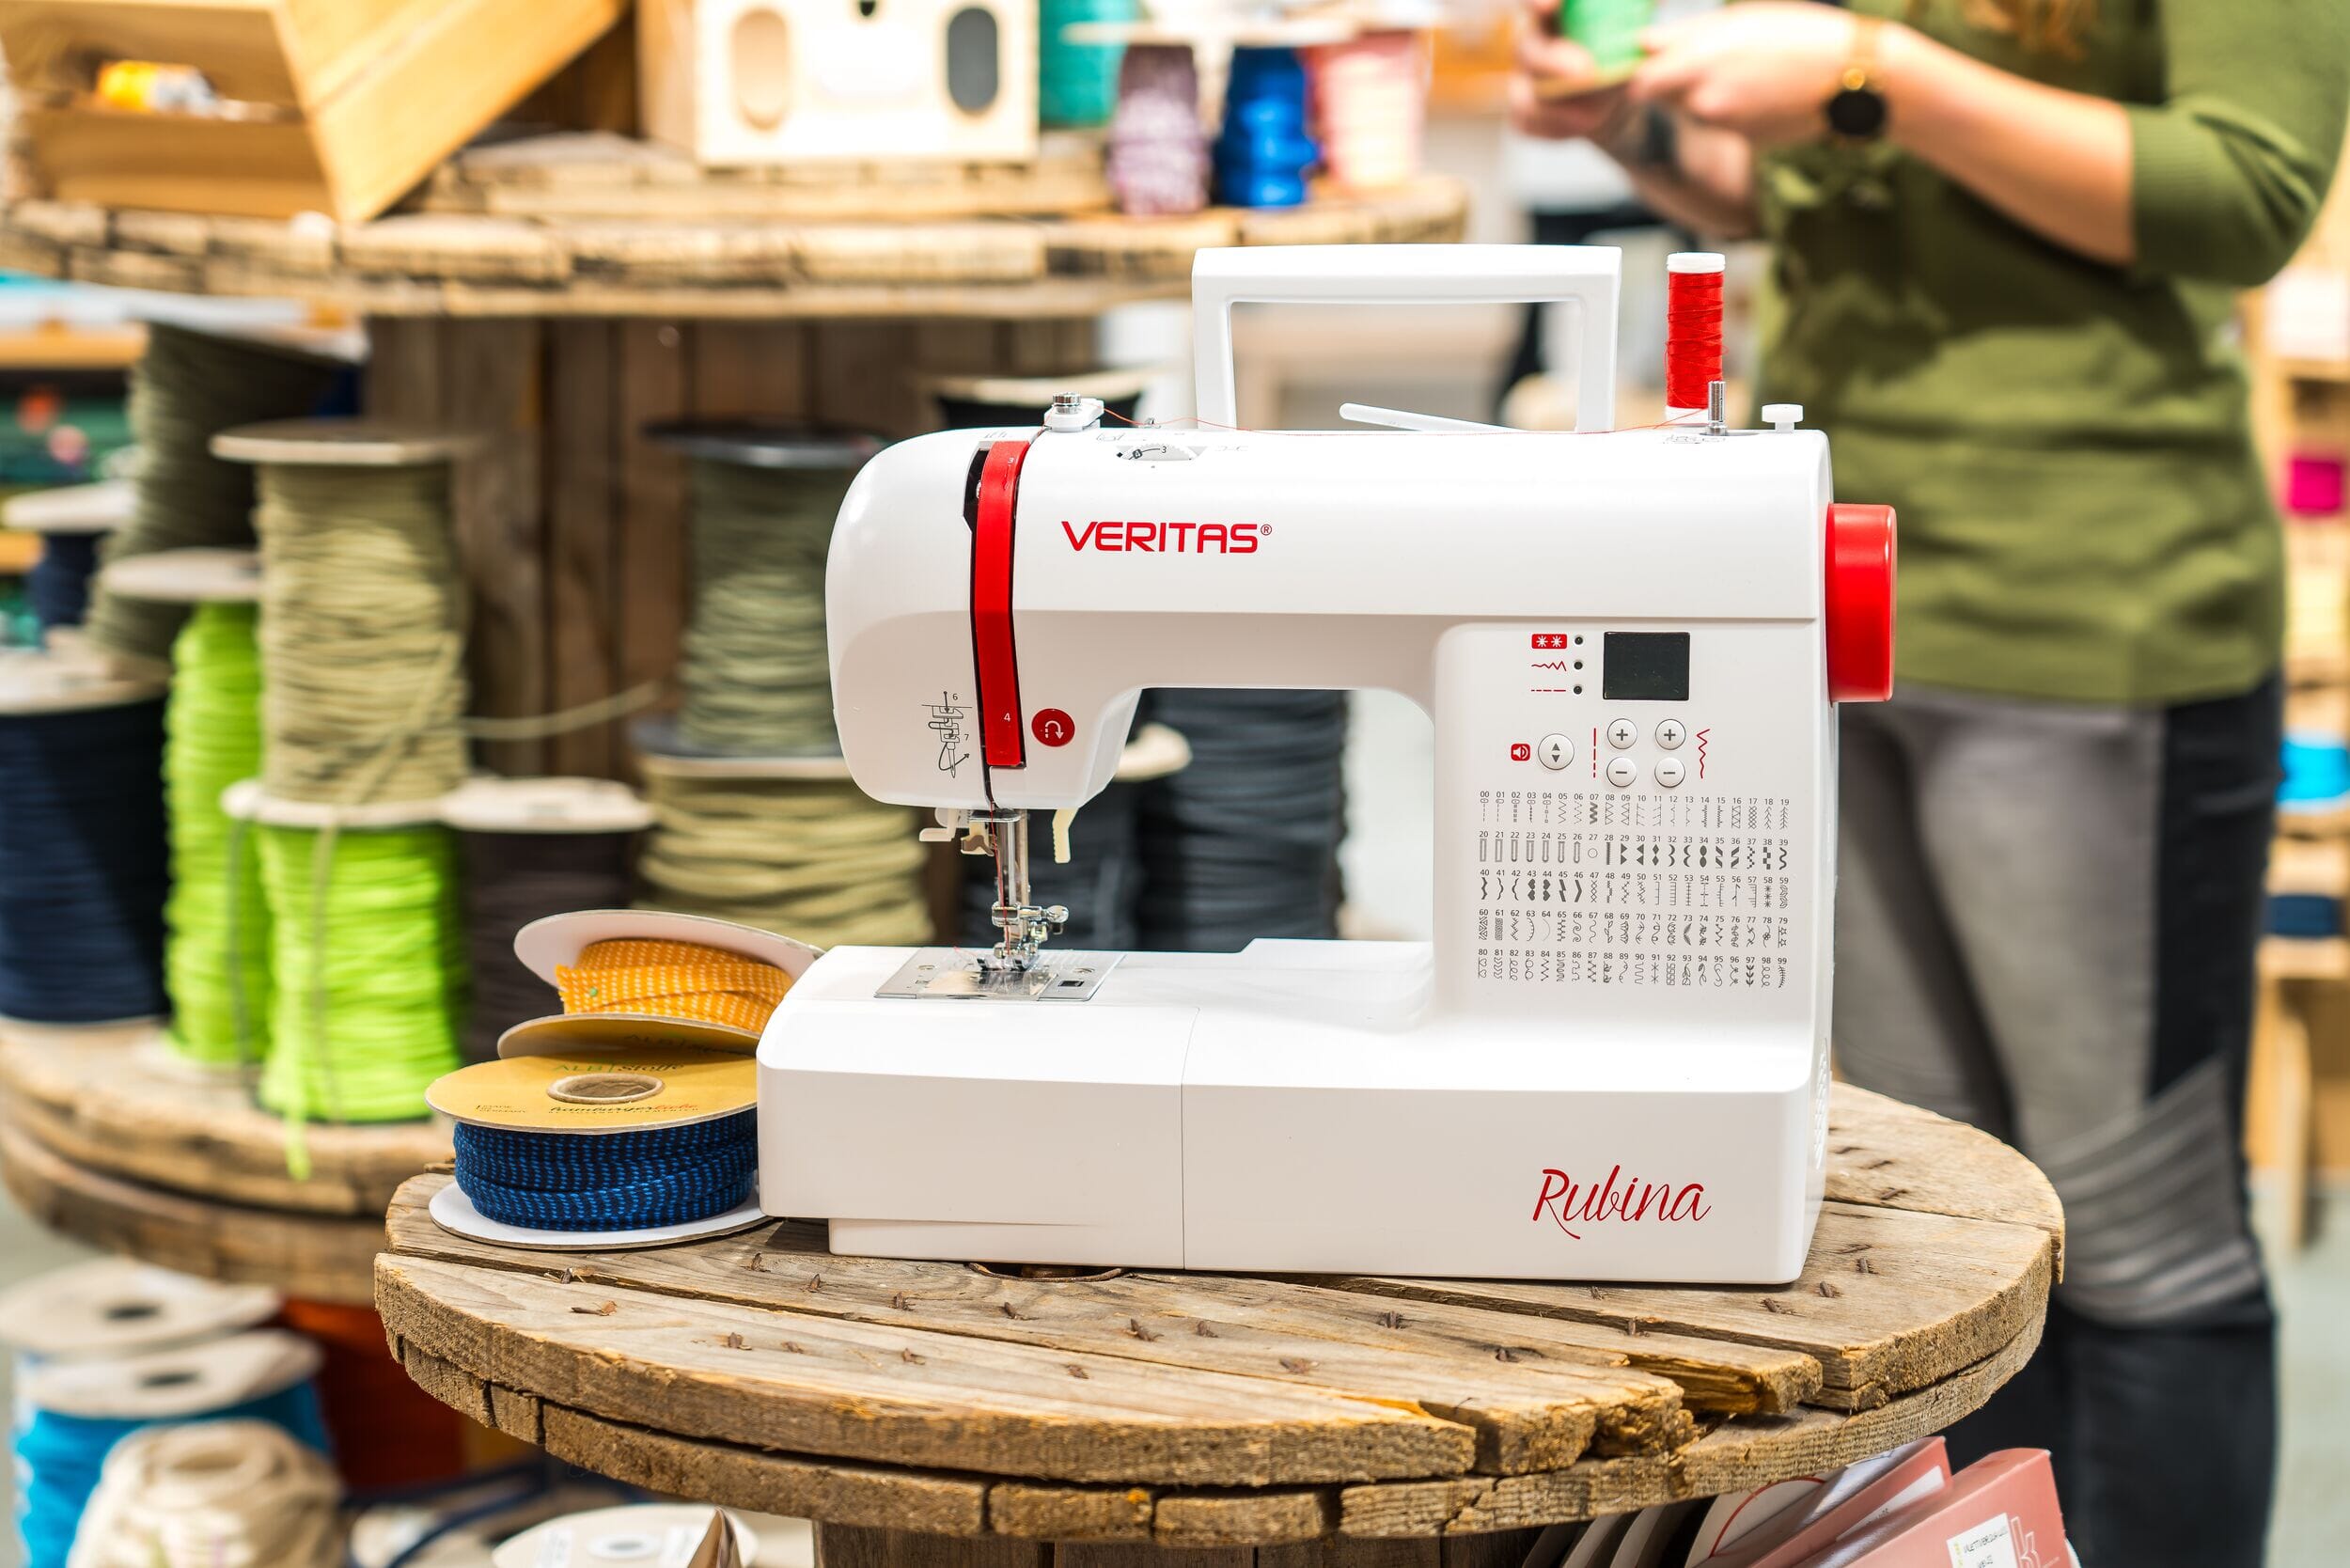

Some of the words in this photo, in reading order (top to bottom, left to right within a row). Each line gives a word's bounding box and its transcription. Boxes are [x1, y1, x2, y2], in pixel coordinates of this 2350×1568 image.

[952, 693, 959, 701] 6
[1004, 713, 1011, 722] 4
[1532, 1165, 1712, 1240] Rubina
